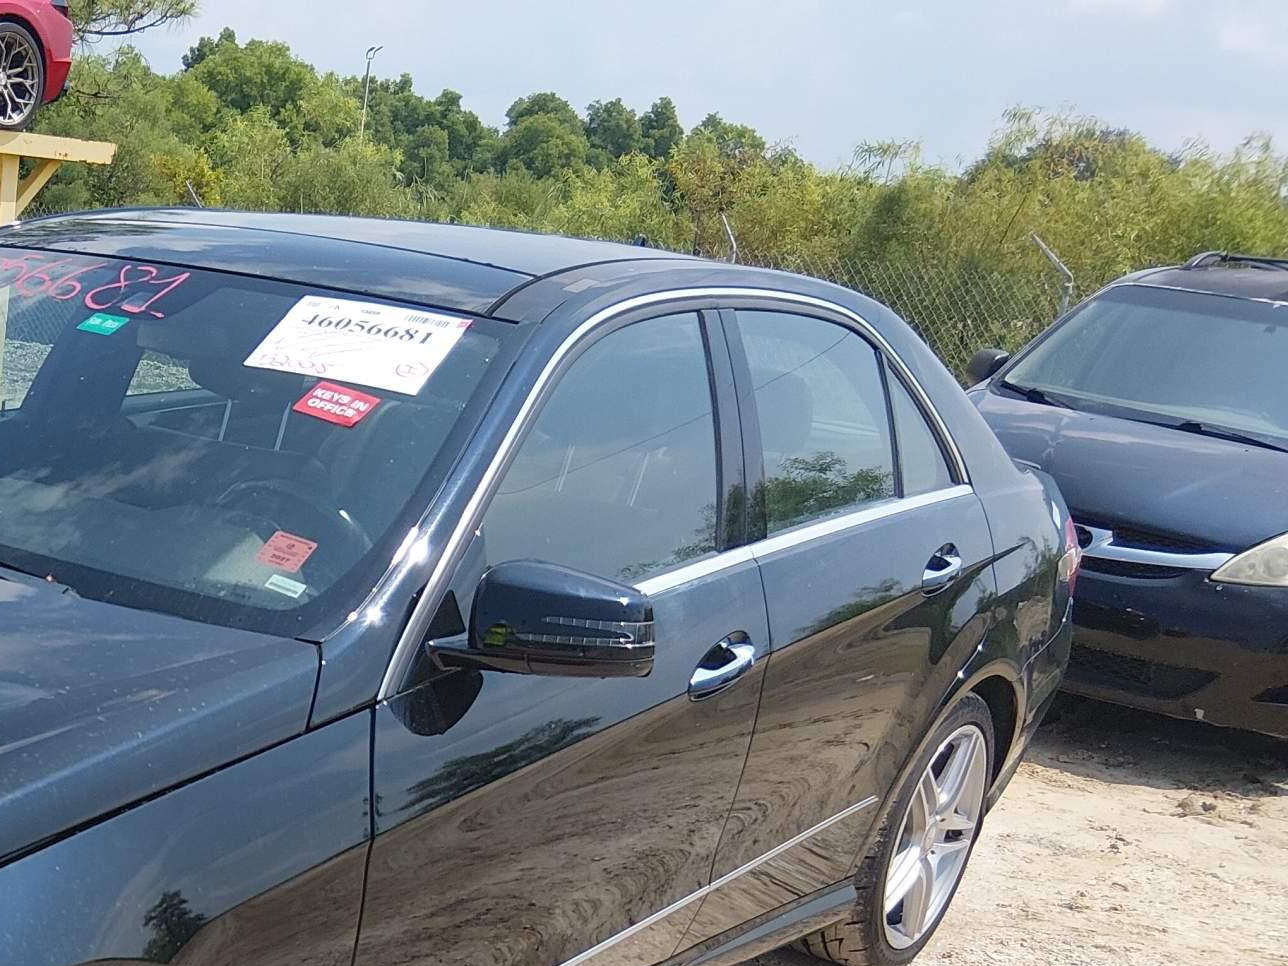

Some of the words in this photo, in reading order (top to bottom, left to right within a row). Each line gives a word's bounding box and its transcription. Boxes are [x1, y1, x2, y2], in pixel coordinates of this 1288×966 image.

[302, 313, 433, 345] 46056681
[307, 398, 358, 417] OFFICE
[313, 388, 351, 404] KEYS
[350, 400, 369, 411] IN
